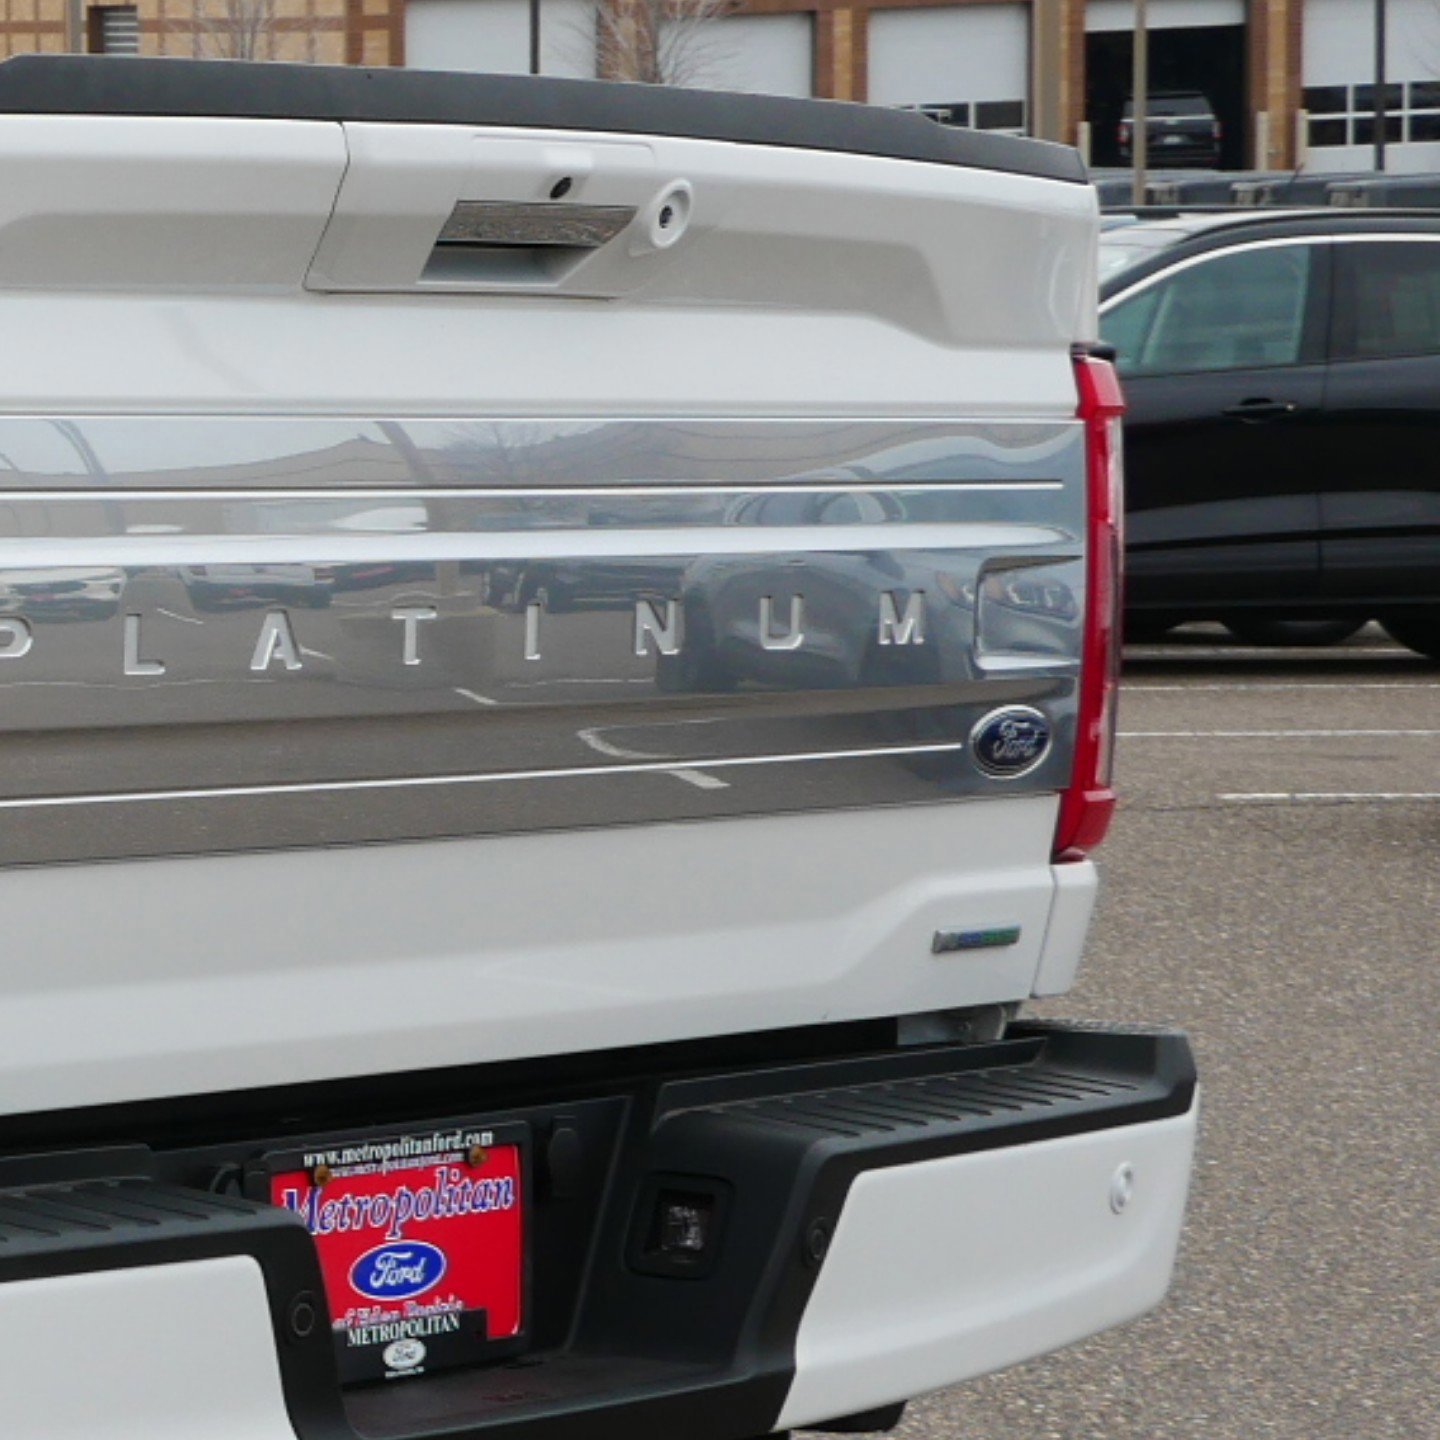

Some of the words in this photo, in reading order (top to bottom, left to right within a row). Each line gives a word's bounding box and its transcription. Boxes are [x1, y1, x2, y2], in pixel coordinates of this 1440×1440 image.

[991, 718, 1038, 760] Ford
[302, 1130, 494, 1167] www.metropolitanford.com
[282, 1166, 515, 1241] Metropolitan
[369, 1251, 427, 1289] Ford
[347, 1312, 461, 1348] METROPOLITAN
